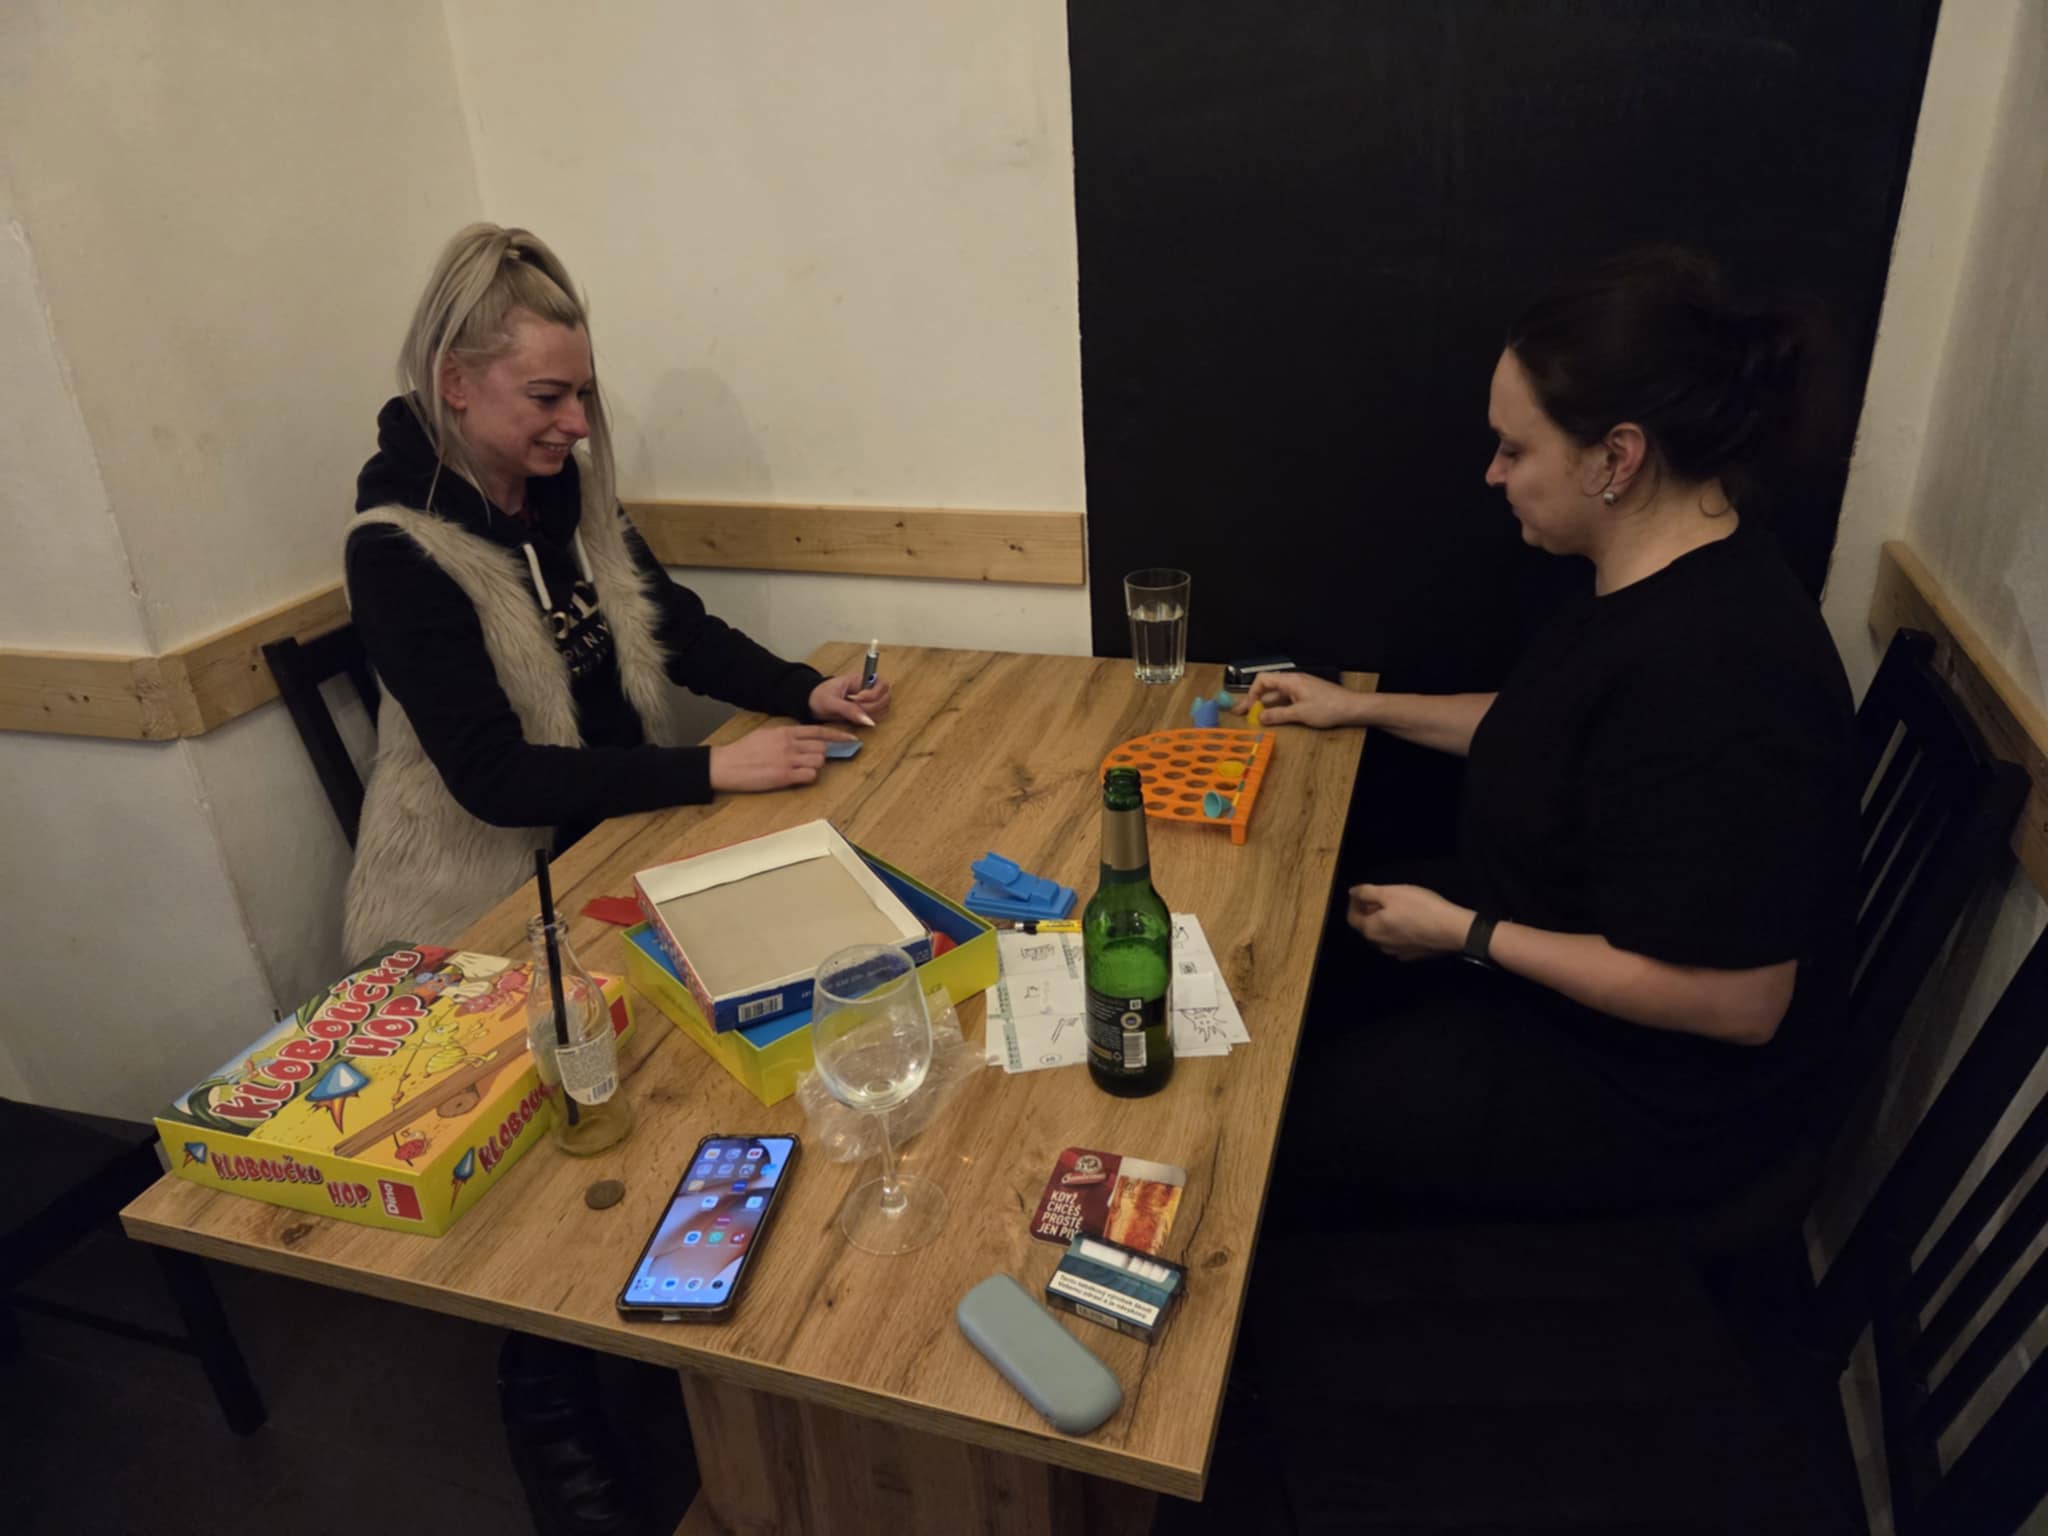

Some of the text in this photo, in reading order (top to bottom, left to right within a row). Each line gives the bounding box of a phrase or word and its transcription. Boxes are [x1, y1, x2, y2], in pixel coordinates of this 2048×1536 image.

[208, 950, 423, 1121] KLOBOUČKU
[340, 994, 430, 1058] HOP
[478, 1074, 554, 1175] KLOBOU
[210, 1151, 371, 1208] KLOBOUČKU HOP
[1037, 1222, 1083, 1241] JEN PIV
